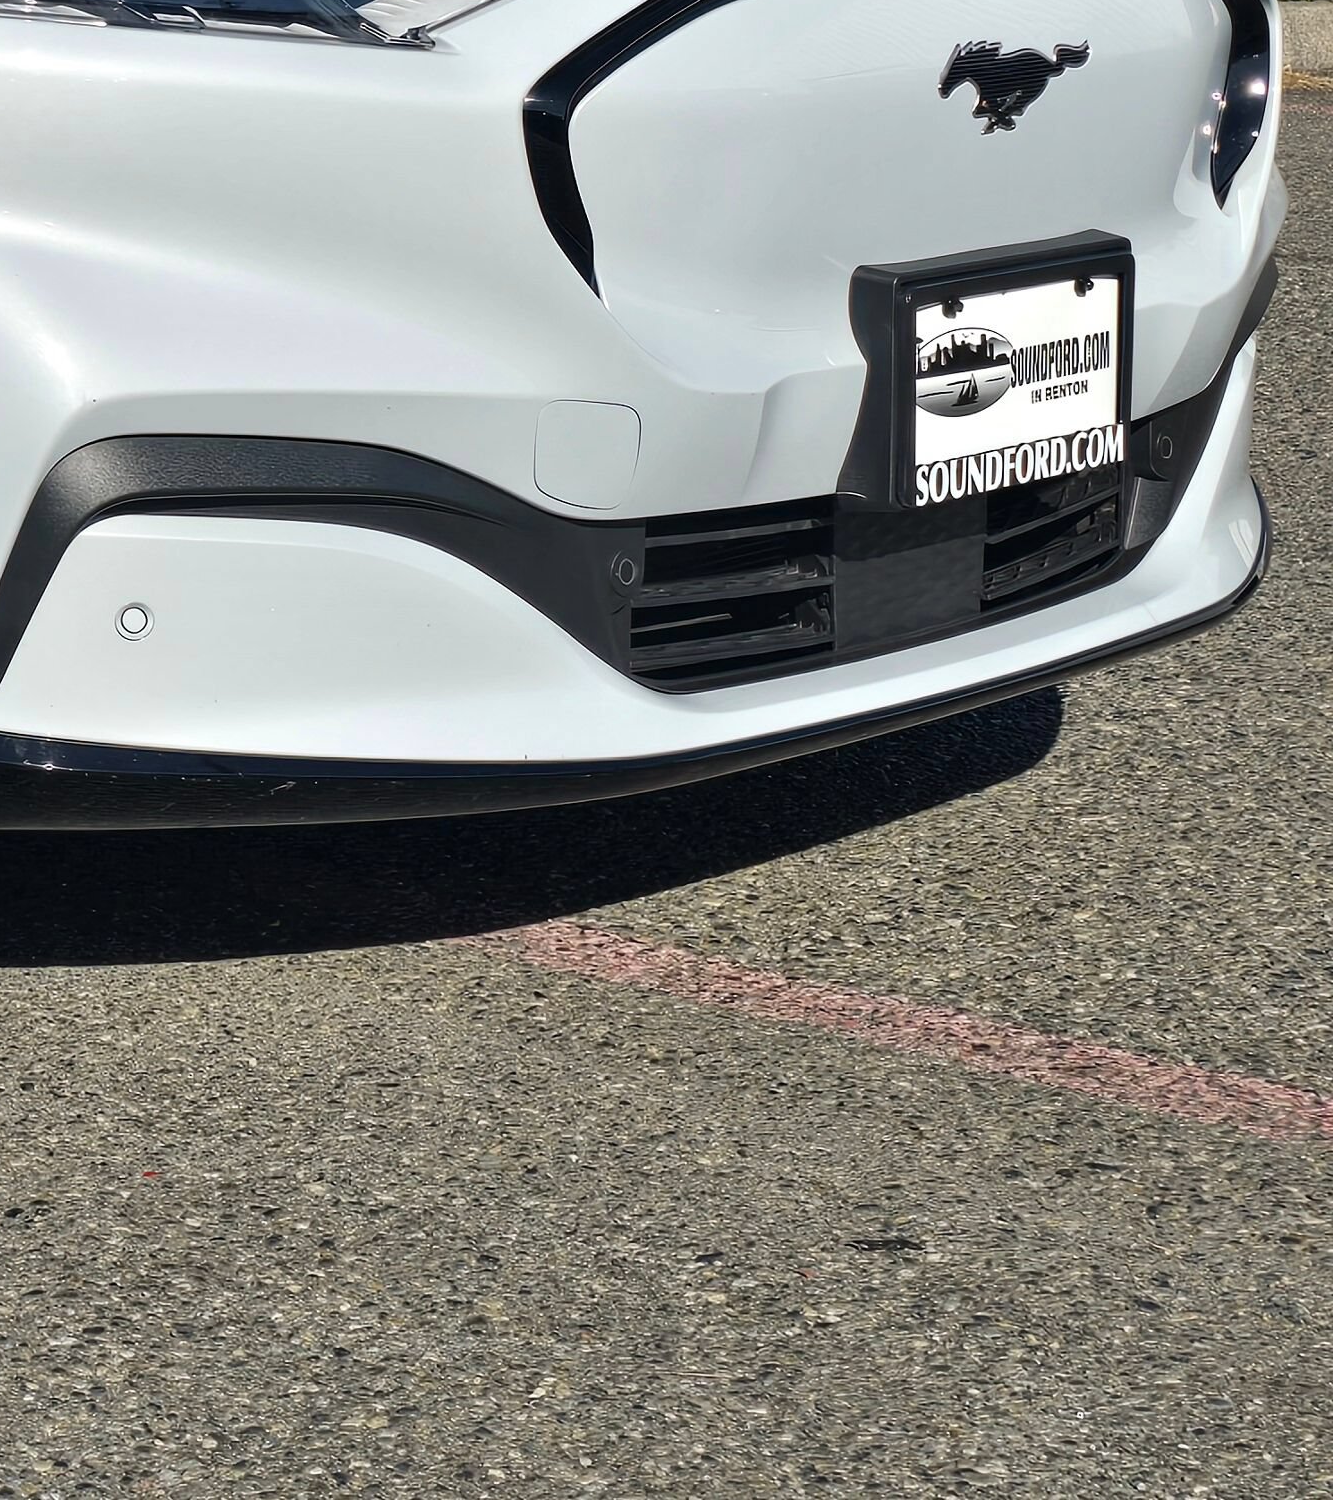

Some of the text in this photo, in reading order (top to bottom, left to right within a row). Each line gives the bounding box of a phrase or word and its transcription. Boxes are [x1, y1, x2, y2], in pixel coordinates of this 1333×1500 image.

[1010, 330, 1111, 389] SOUNDFORD.COM
[1030, 379, 1089, 405] IN RENTON
[915, 423, 1125, 507] SOUNDFORD.COM
